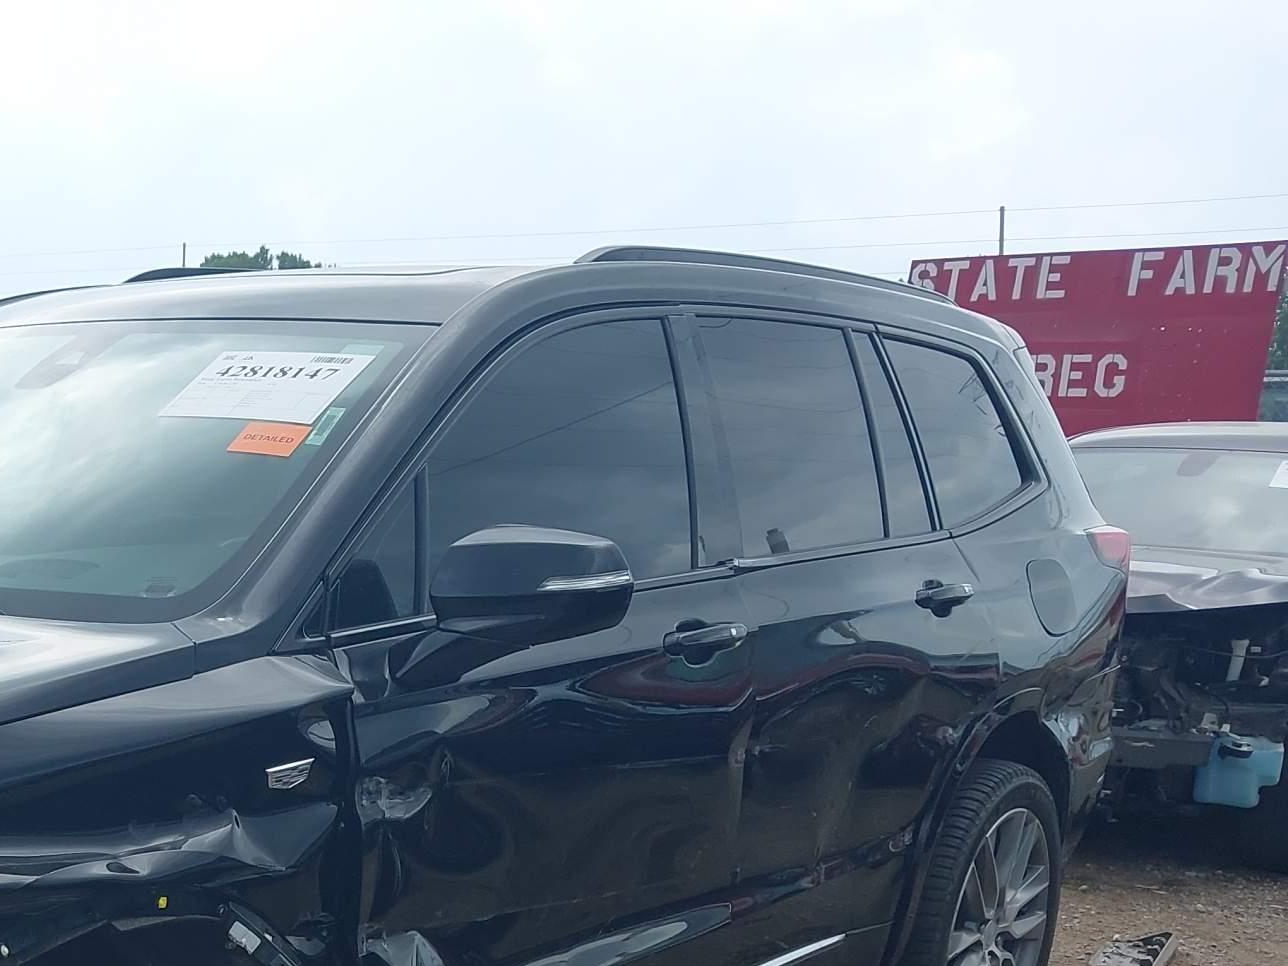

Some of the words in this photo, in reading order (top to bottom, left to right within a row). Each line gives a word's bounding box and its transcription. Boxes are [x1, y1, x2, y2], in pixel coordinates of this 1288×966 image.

[911, 255, 1071, 302] STATE
[1127, 244, 1286, 297] FARM
[216, 365, 342, 381] 42818147
[244, 433, 295, 444] DETAILED
